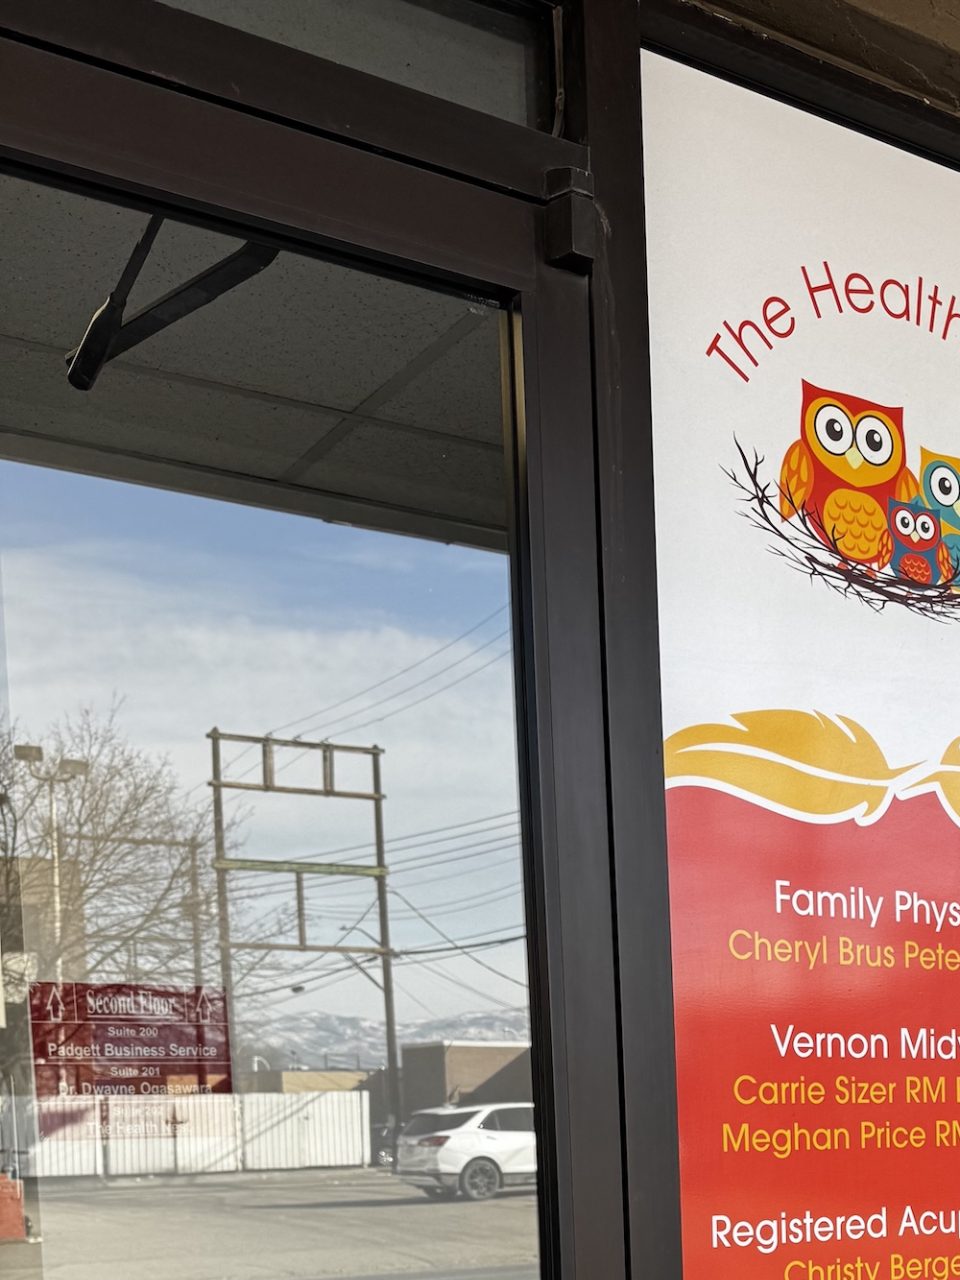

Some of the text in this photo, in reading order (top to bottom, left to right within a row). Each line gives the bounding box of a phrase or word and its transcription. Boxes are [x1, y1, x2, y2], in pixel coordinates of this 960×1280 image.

[706, 296, 795, 382] The
[775, 879, 883, 928] Family
[728, 930, 827, 970] Cheryl
[839, 936, 895, 968] Brus
[86, 990, 176, 1014] Second Floor
[108, 1026, 158, 1036] Suite 200
[770, 1024, 888, 1058] Vernon
[48, 1043, 217, 1058] Padgett Business Service
[111, 1067, 160, 1076] Suite 201
[59, 1082, 212, 1095] Dr. Dwayne Ogasawara
[733, 1075, 825, 1105] Carrie
[835, 1076, 896, 1104] Sizer
[905, 1078, 946, 1103] RM
[722, 1123, 849, 1159] Meghan
[861, 1122, 925, 1149] Price
[711, 1207, 887, 1255] Registered
